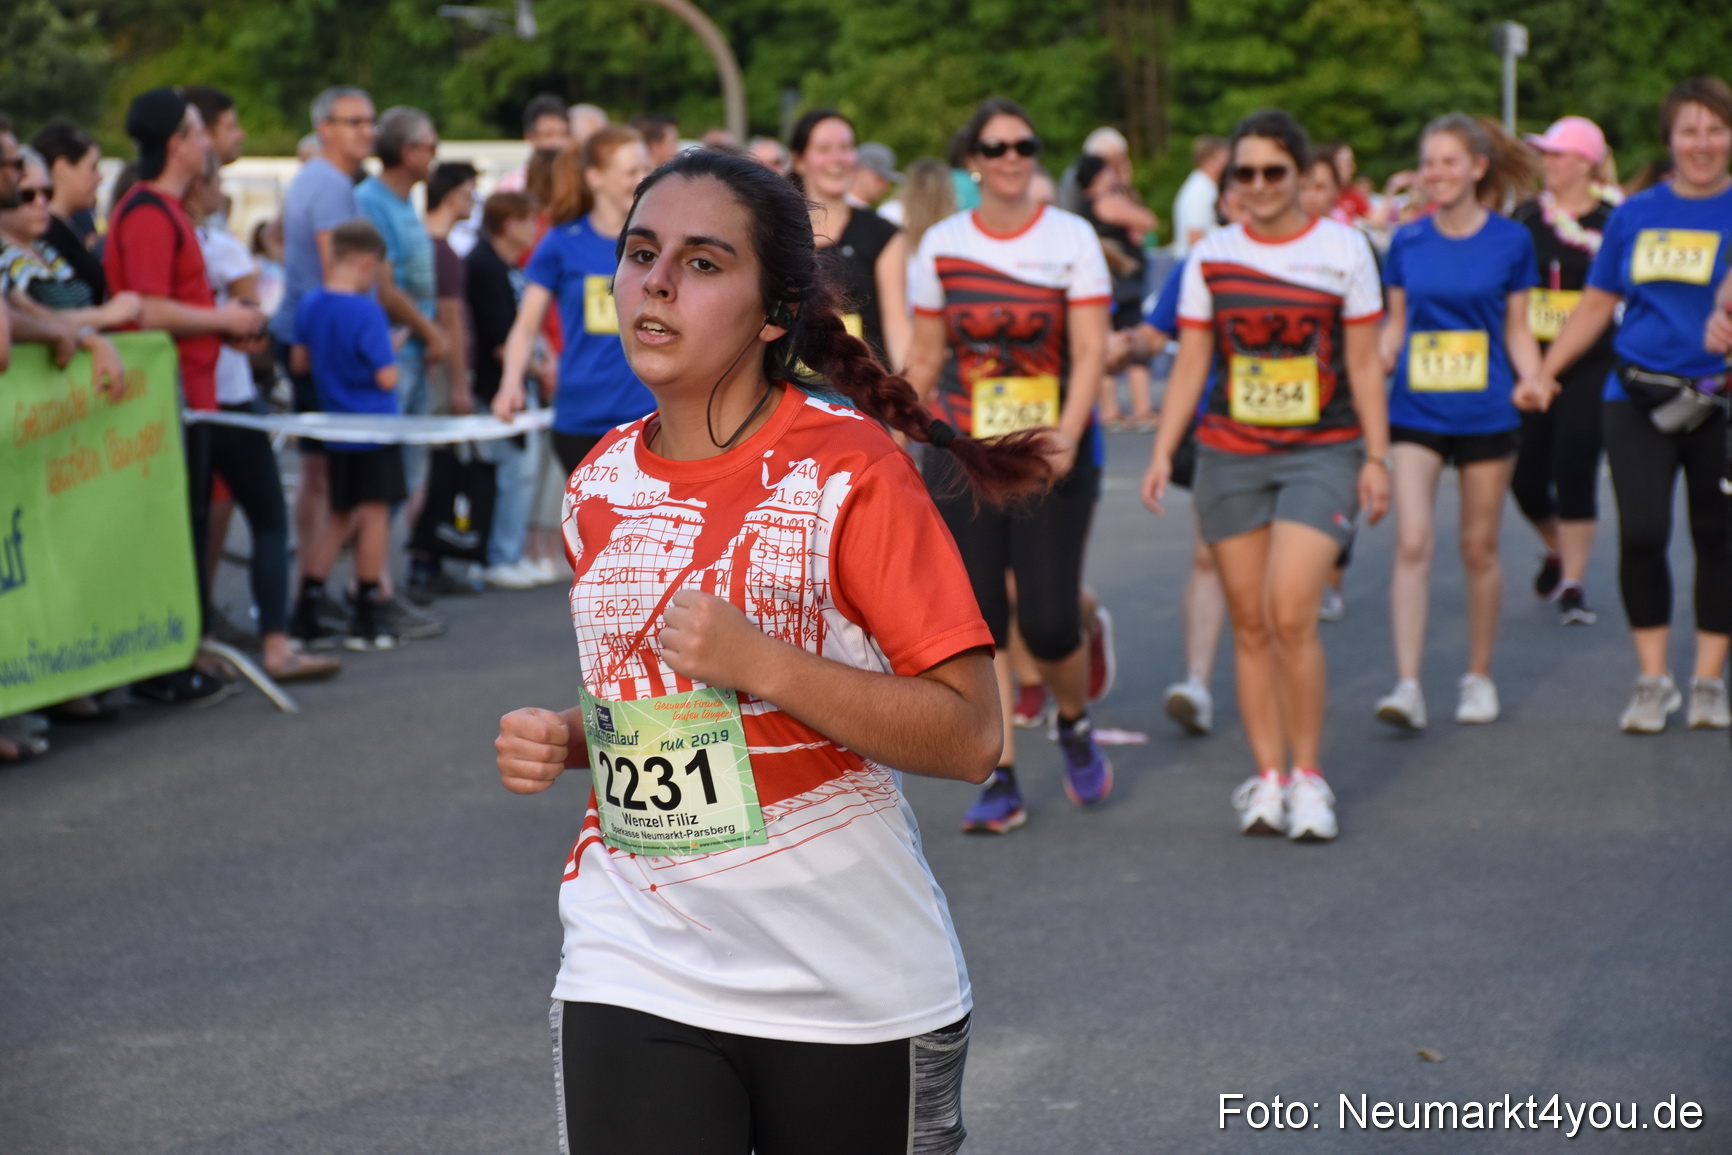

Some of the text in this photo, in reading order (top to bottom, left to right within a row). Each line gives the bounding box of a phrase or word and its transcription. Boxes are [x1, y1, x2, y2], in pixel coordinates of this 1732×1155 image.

[1242, 380, 1304, 403] 2254
[594, 598, 641, 619] 26.22
[653, 698, 724, 711] Gesunde Firmen
[672, 709, 733, 723] laufen länger!
[691, 729, 729, 748] 2019
[598, 748, 718, 811] 2231
[621, 811, 699, 828] Wenzel Filiz
[611, 822, 736, 841] Sparkasse Neumarkt-Parsberg
